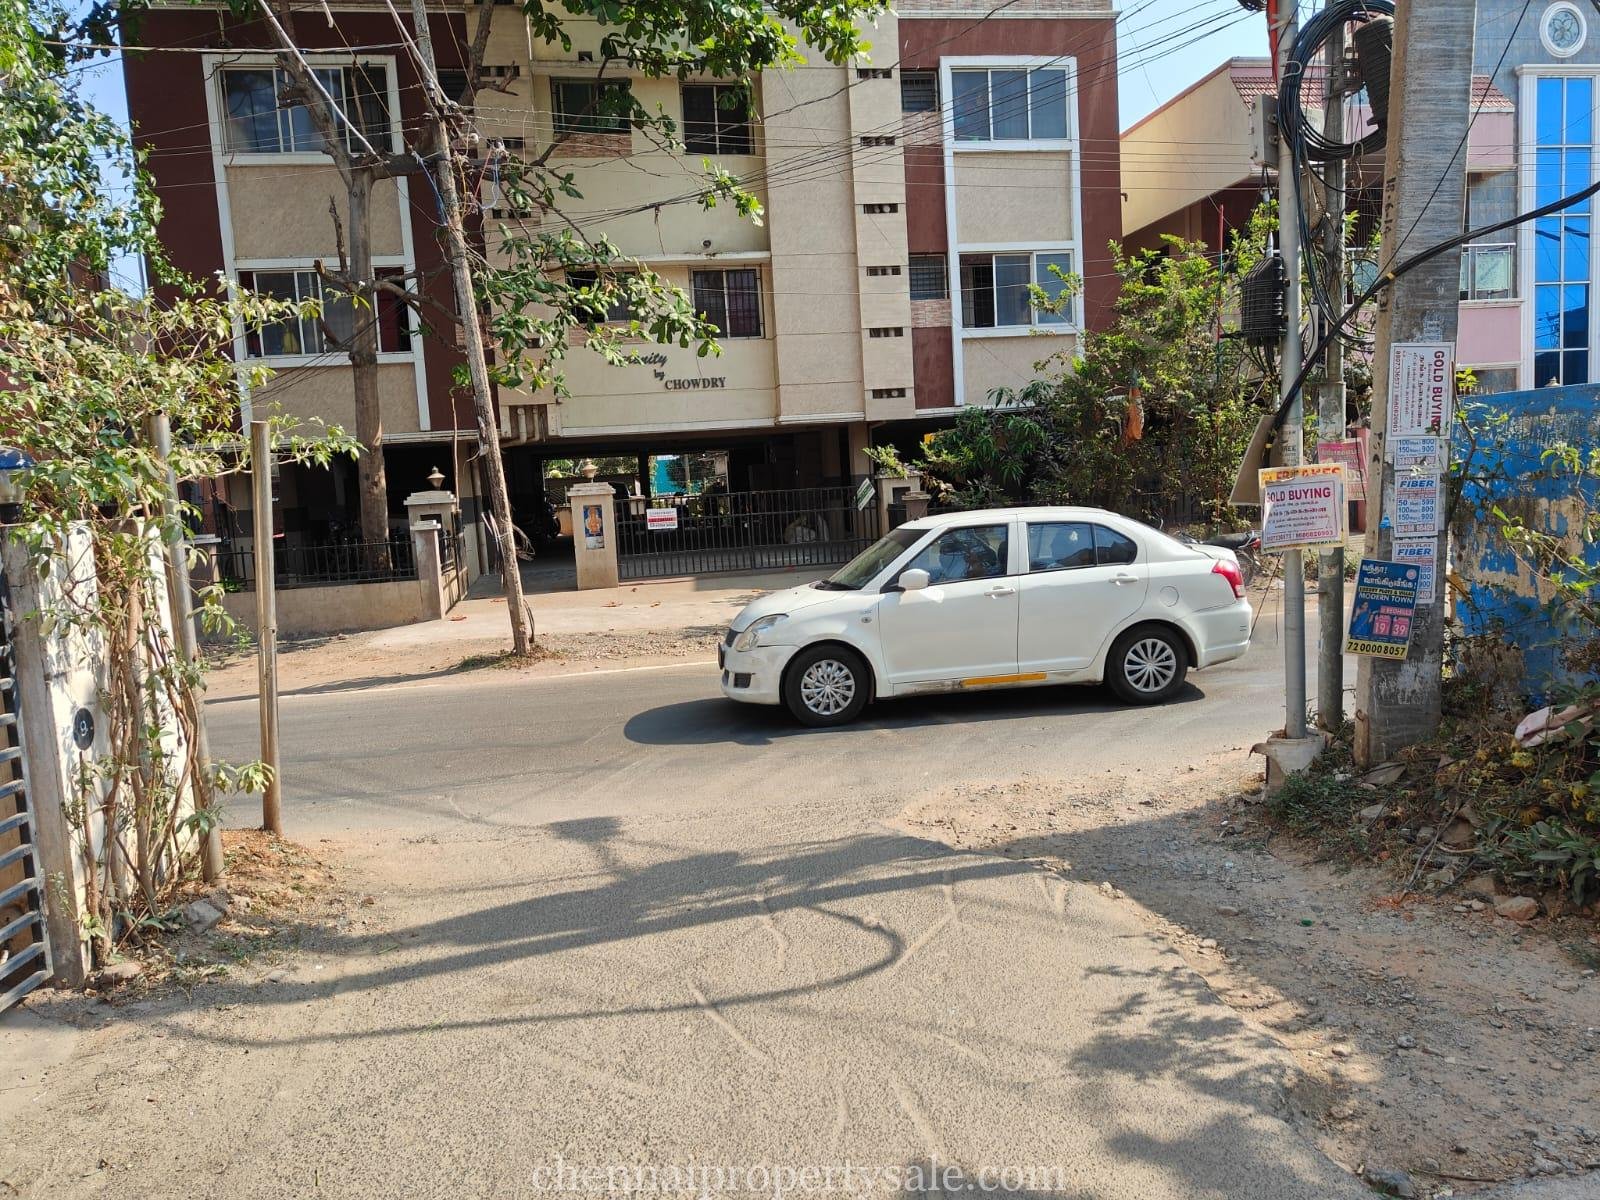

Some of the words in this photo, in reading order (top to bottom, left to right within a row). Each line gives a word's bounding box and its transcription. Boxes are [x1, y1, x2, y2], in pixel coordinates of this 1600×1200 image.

[1434, 350, 1445, 383] GOLD
[653, 369, 666, 380] by
[665, 377, 726, 390] CHOWDRY
[1400, 480, 1435, 488] FIBER
[1288, 487, 1332, 501] BUYING
[1397, 548, 1432, 556] FIBER
[1358, 592, 1389, 601] MODERN
[1391, 596, 1413, 604] TOWN
[1375, 622, 1386, 633] 19
[1393, 624, 1406, 635] 39
